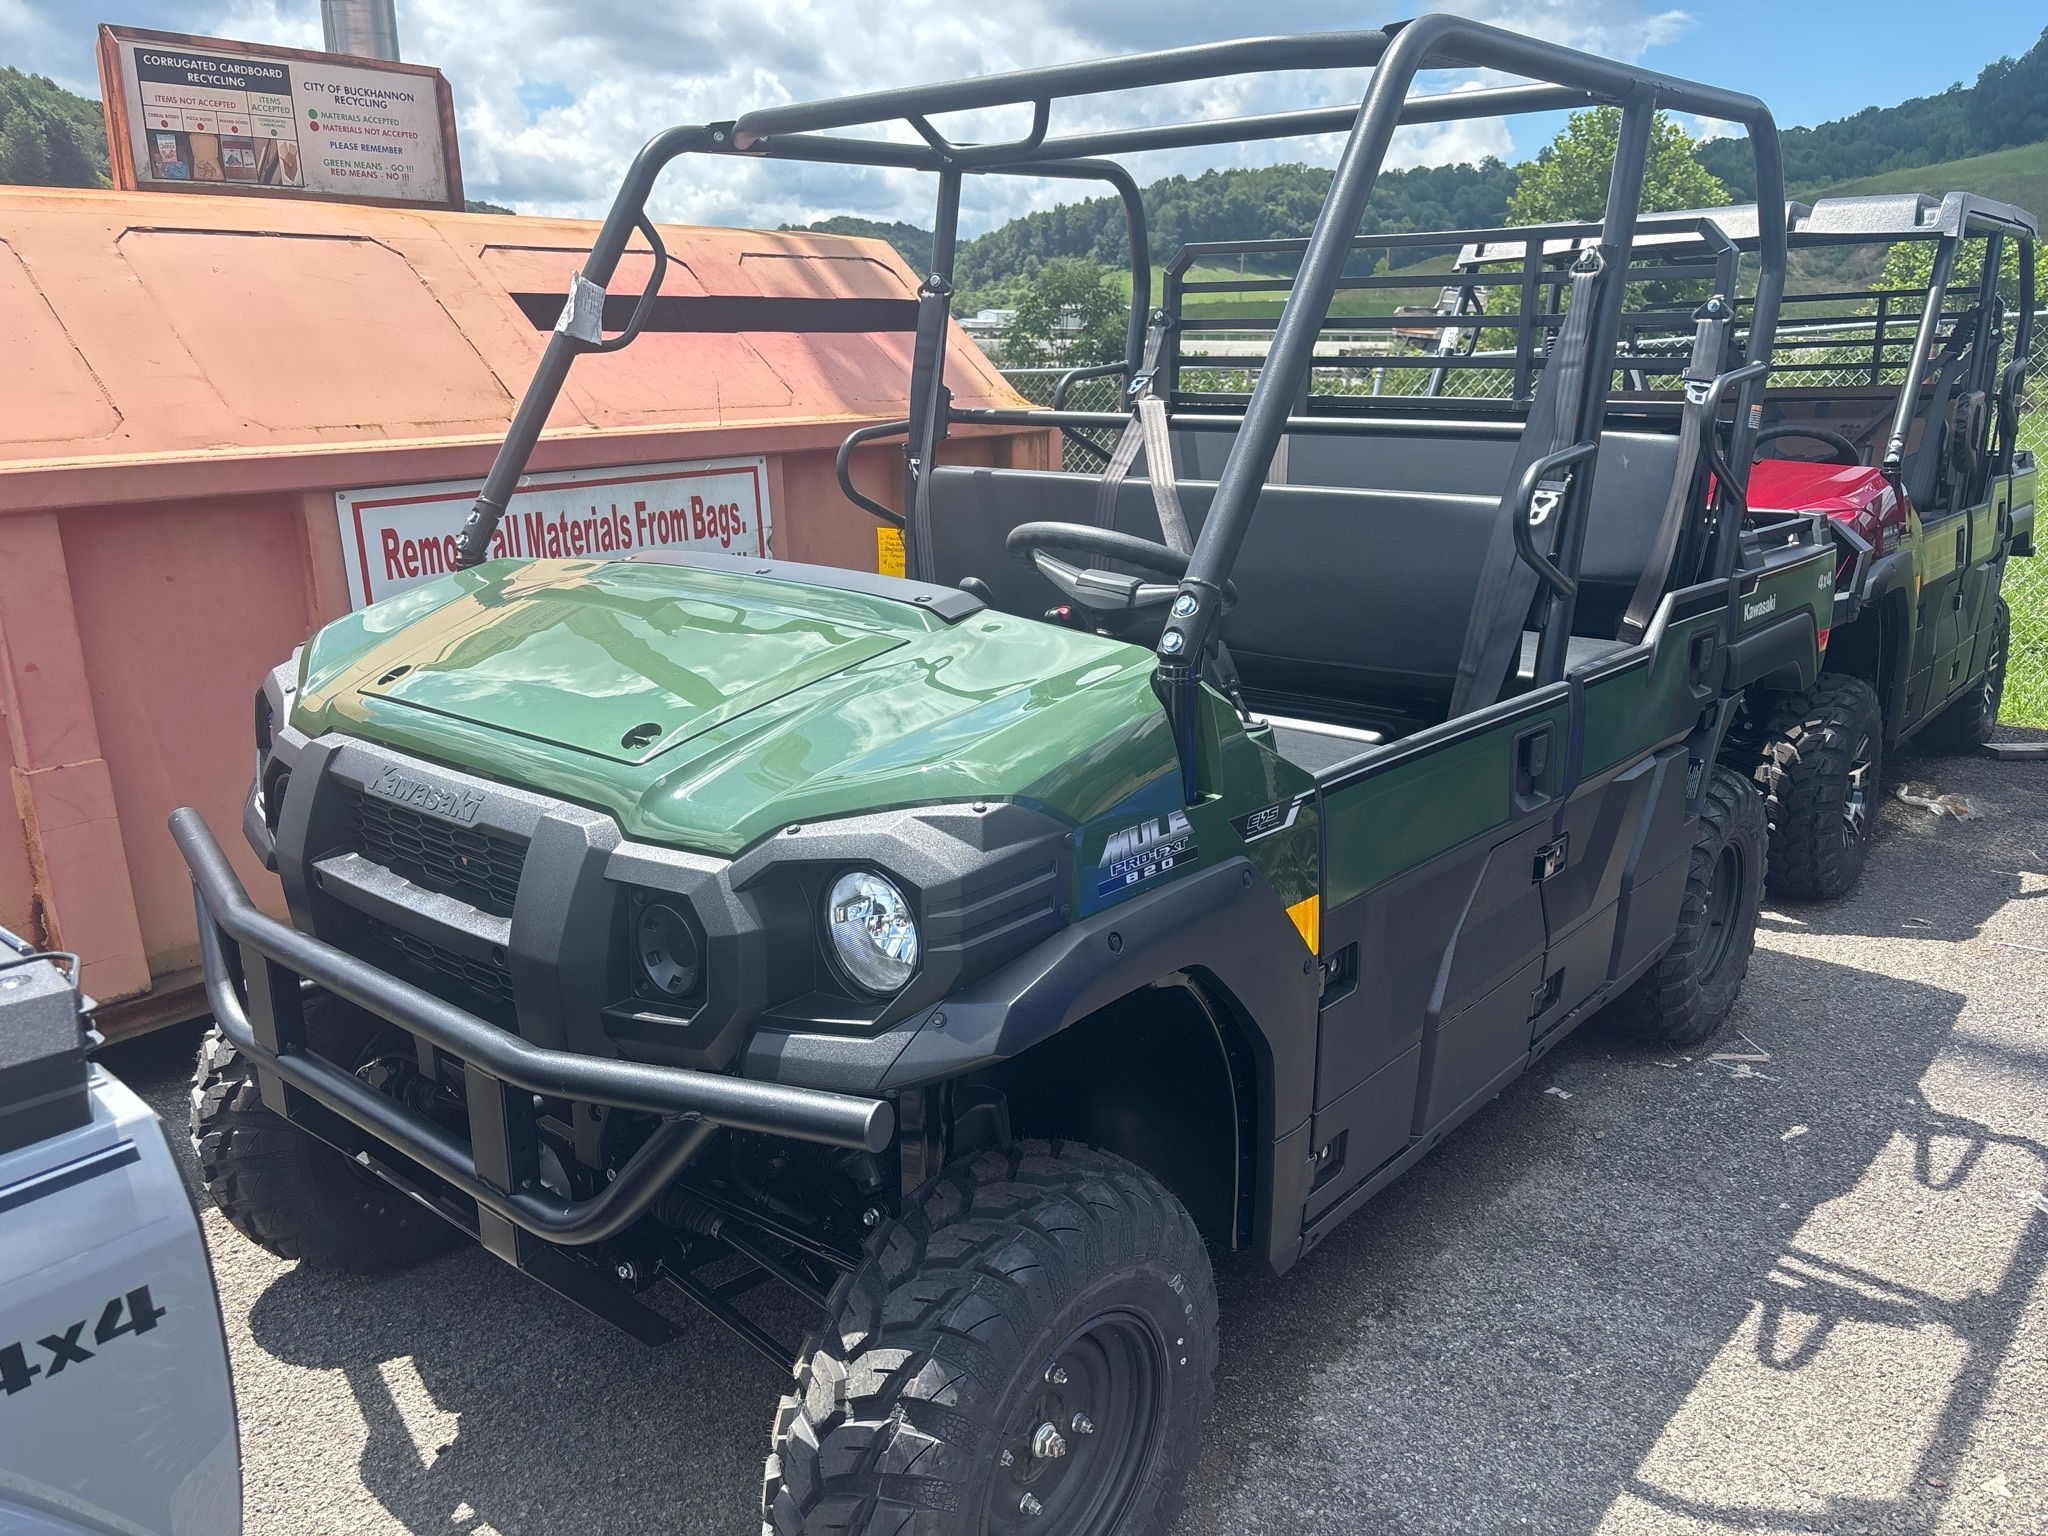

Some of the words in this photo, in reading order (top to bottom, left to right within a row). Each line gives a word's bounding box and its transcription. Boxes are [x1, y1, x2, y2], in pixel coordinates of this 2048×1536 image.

[143, 54, 217, 72] CORRUGATED
[219, 63, 283, 79] CARDBOARD
[187, 72, 246, 87] RECYCLING
[259, 96, 281, 105] ITEMS
[303, 81, 325, 93] CITY
[327, 84, 341, 94] OF
[344, 86, 415, 102] BUCKHANNON
[154, 94, 178, 104] ITEMS
[179, 97, 196, 106] NOT
[198, 99, 236, 109] ACCEPTED
[251, 104, 291, 114] ACCEPTED
[334, 95, 388, 109] RECYCLING
[321, 111, 361, 123] MATERIALS
[363, 115, 400, 126] ACCEPTED
[322, 123, 363, 135] MATERIALS
[364, 127, 381, 136] NOT
[382, 129, 418, 140] ACCEPTED
[329, 140, 359, 151] PLEASE
[360, 143, 404, 155] REMEMBER
[323, 158, 351, 169] GREEN
[353, 160, 383, 171] MEANS
[390, 164, 404, 172] GO
[406, 165, 414, 173] !!!
[330, 168, 347, 177] RED
[348, 169, 378, 179] MEANS
[386, 172, 400, 181] NO
[401, 173, 410, 181] !!!
[381, 527, 458, 580] Remo
[491, 514, 522, 559] all
[524, 503, 633, 559] Materials
[634, 501, 689, 548] From
[690, 496, 747, 549] Bags.
[1817, 571, 1832, 590] 4x4
[1743, 593, 1777, 622] Kawasaki
[368, 764, 486, 823] Kawasaki
[1246, 805, 1280, 830] EPS
[1098, 809, 1195, 869] MULE
[1110, 836, 1189, 877] PRO-FXT
[0, 1284, 166, 1396] 4x4
